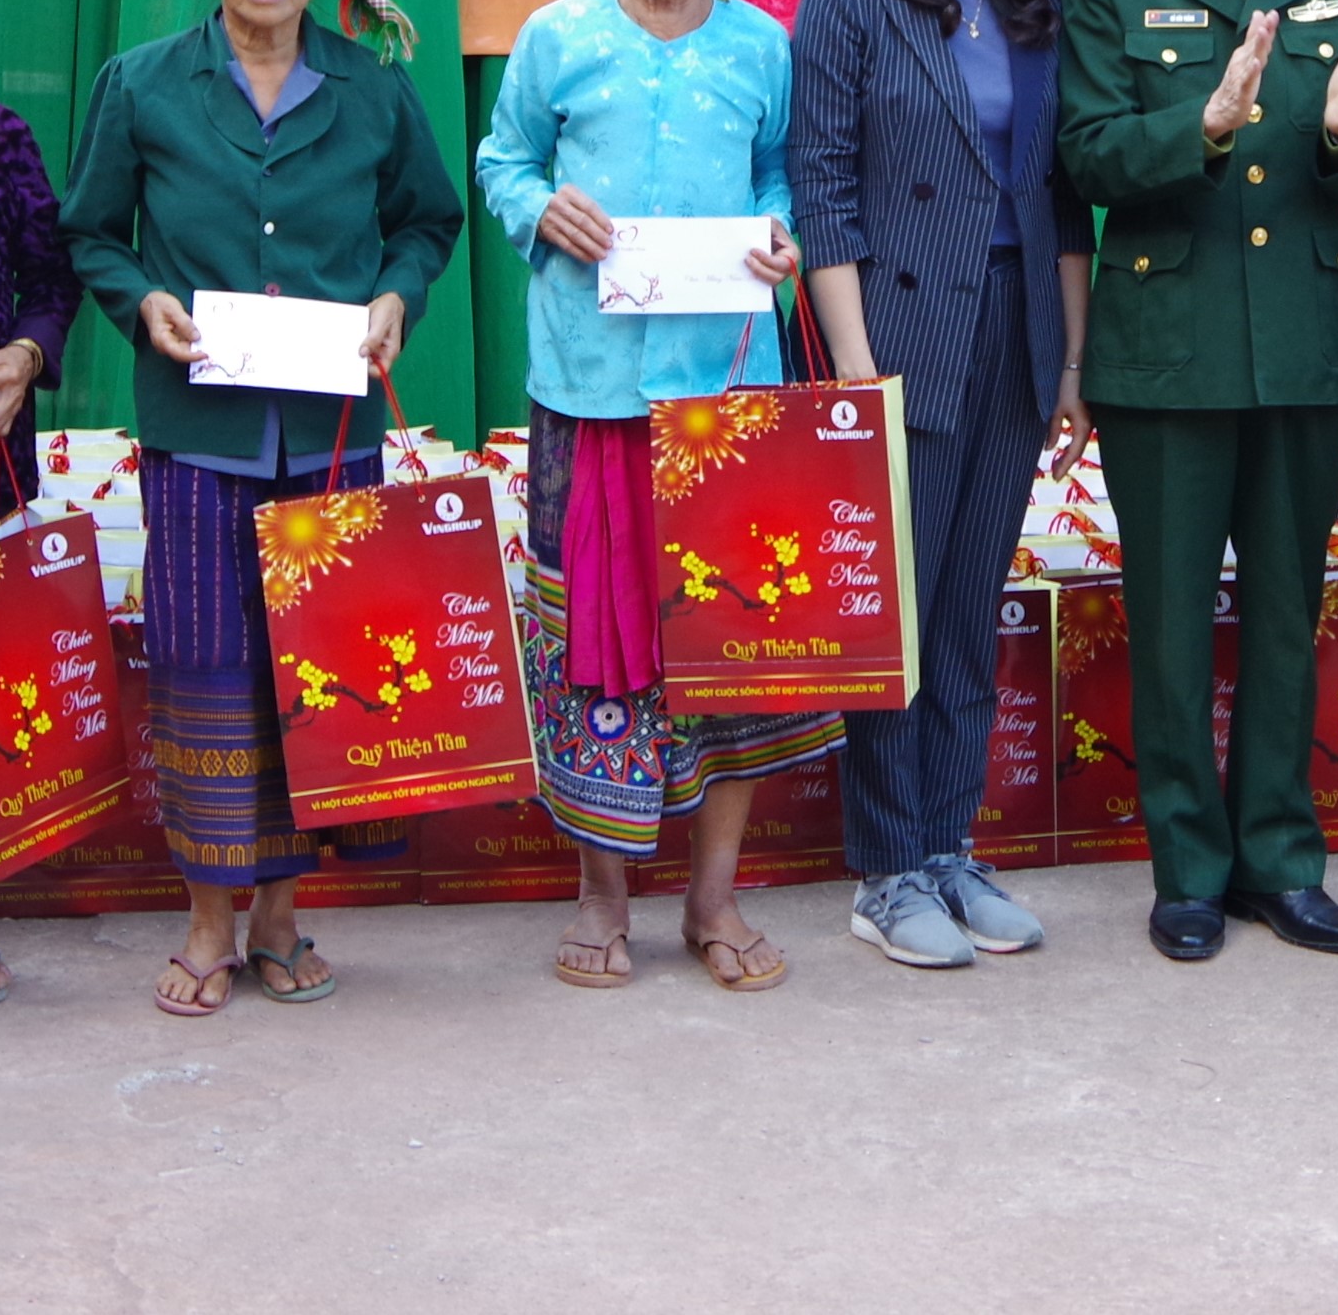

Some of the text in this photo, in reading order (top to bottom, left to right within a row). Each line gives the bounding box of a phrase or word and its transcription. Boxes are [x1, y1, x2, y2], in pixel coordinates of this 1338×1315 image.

[829, 499, 875, 523] Chúc
[442, 592, 490, 615] Chúc
[51, 629, 92, 653] Chúc
[722, 637, 841, 663] Quỹ Thiện Tâm
[346, 732, 467, 767] Quỹ Thiện Tâm
[0, 768, 83, 817] Quỹ Thiện Tâm
[447, 780, 468, 790] CHO
